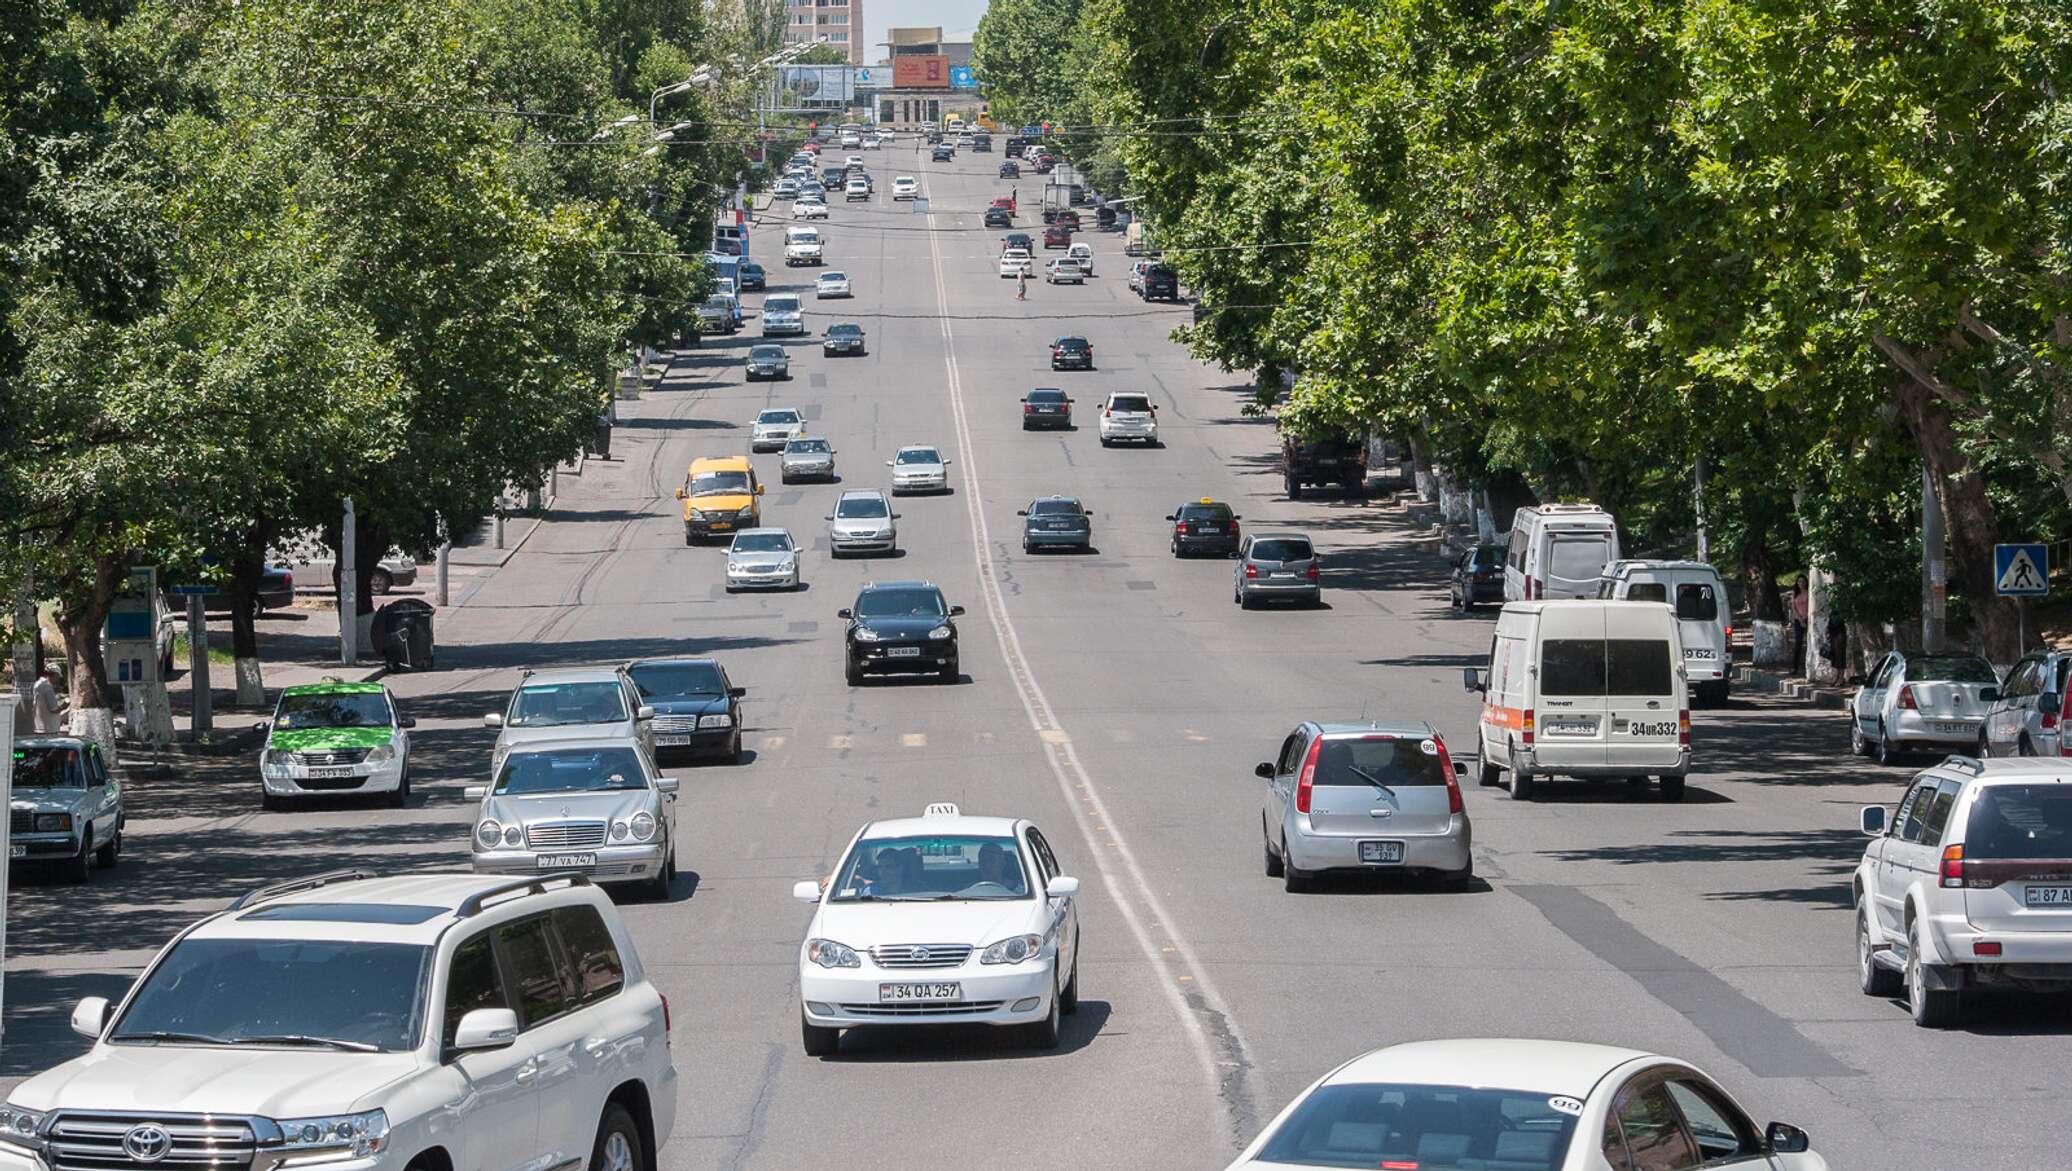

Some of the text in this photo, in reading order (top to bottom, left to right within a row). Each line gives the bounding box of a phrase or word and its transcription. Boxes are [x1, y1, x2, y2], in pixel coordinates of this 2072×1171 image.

[1632, 722, 1677, 736] 34UR332
[930, 805, 954, 815] TAXI
[2043, 888, 2072, 902] 87 A
[896, 985, 911, 998] 34
[914, 985, 932, 998] QA
[935, 983, 956, 998] 257
